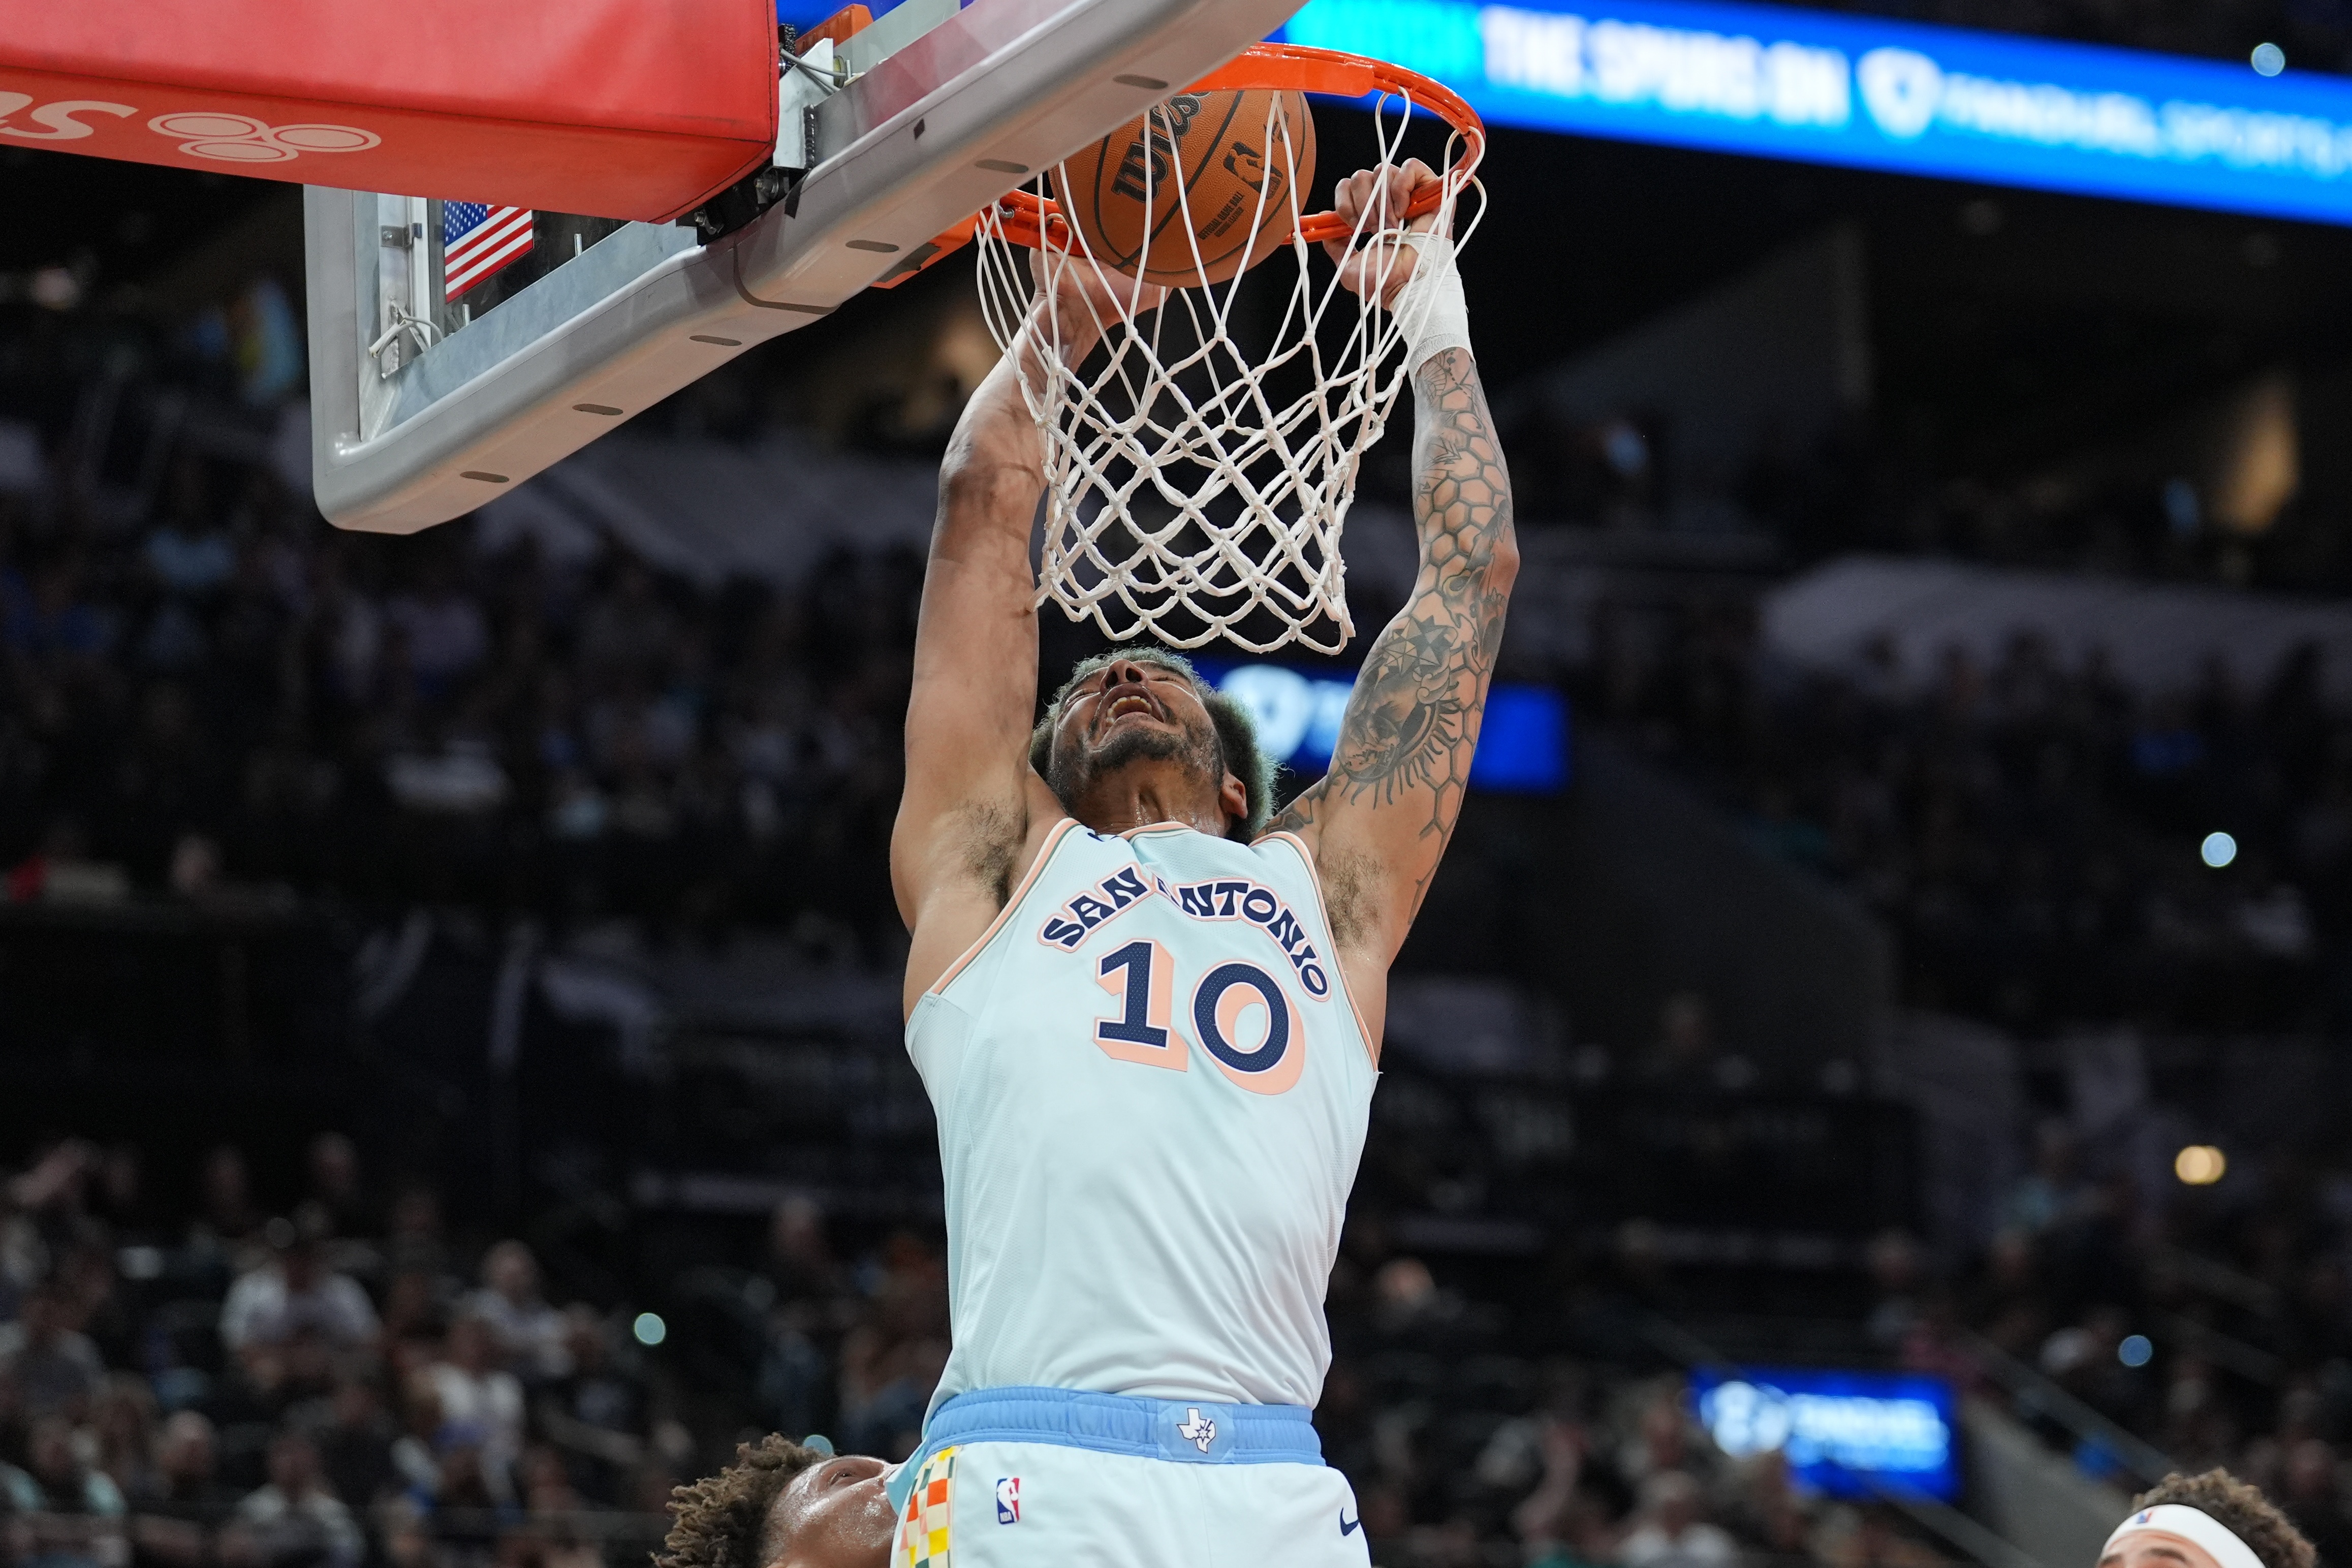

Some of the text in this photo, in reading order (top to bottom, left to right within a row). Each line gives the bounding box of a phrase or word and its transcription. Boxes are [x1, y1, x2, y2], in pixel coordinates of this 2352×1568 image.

[1111, 91, 1212, 203] Wils
[1197, 191, 1244, 240] OFFICIAL GAME BALL
[1042, 865, 1150, 949] SAN
[1096, 939, 1292, 1074] 10
[999, 1511, 1012, 1522] NBA
